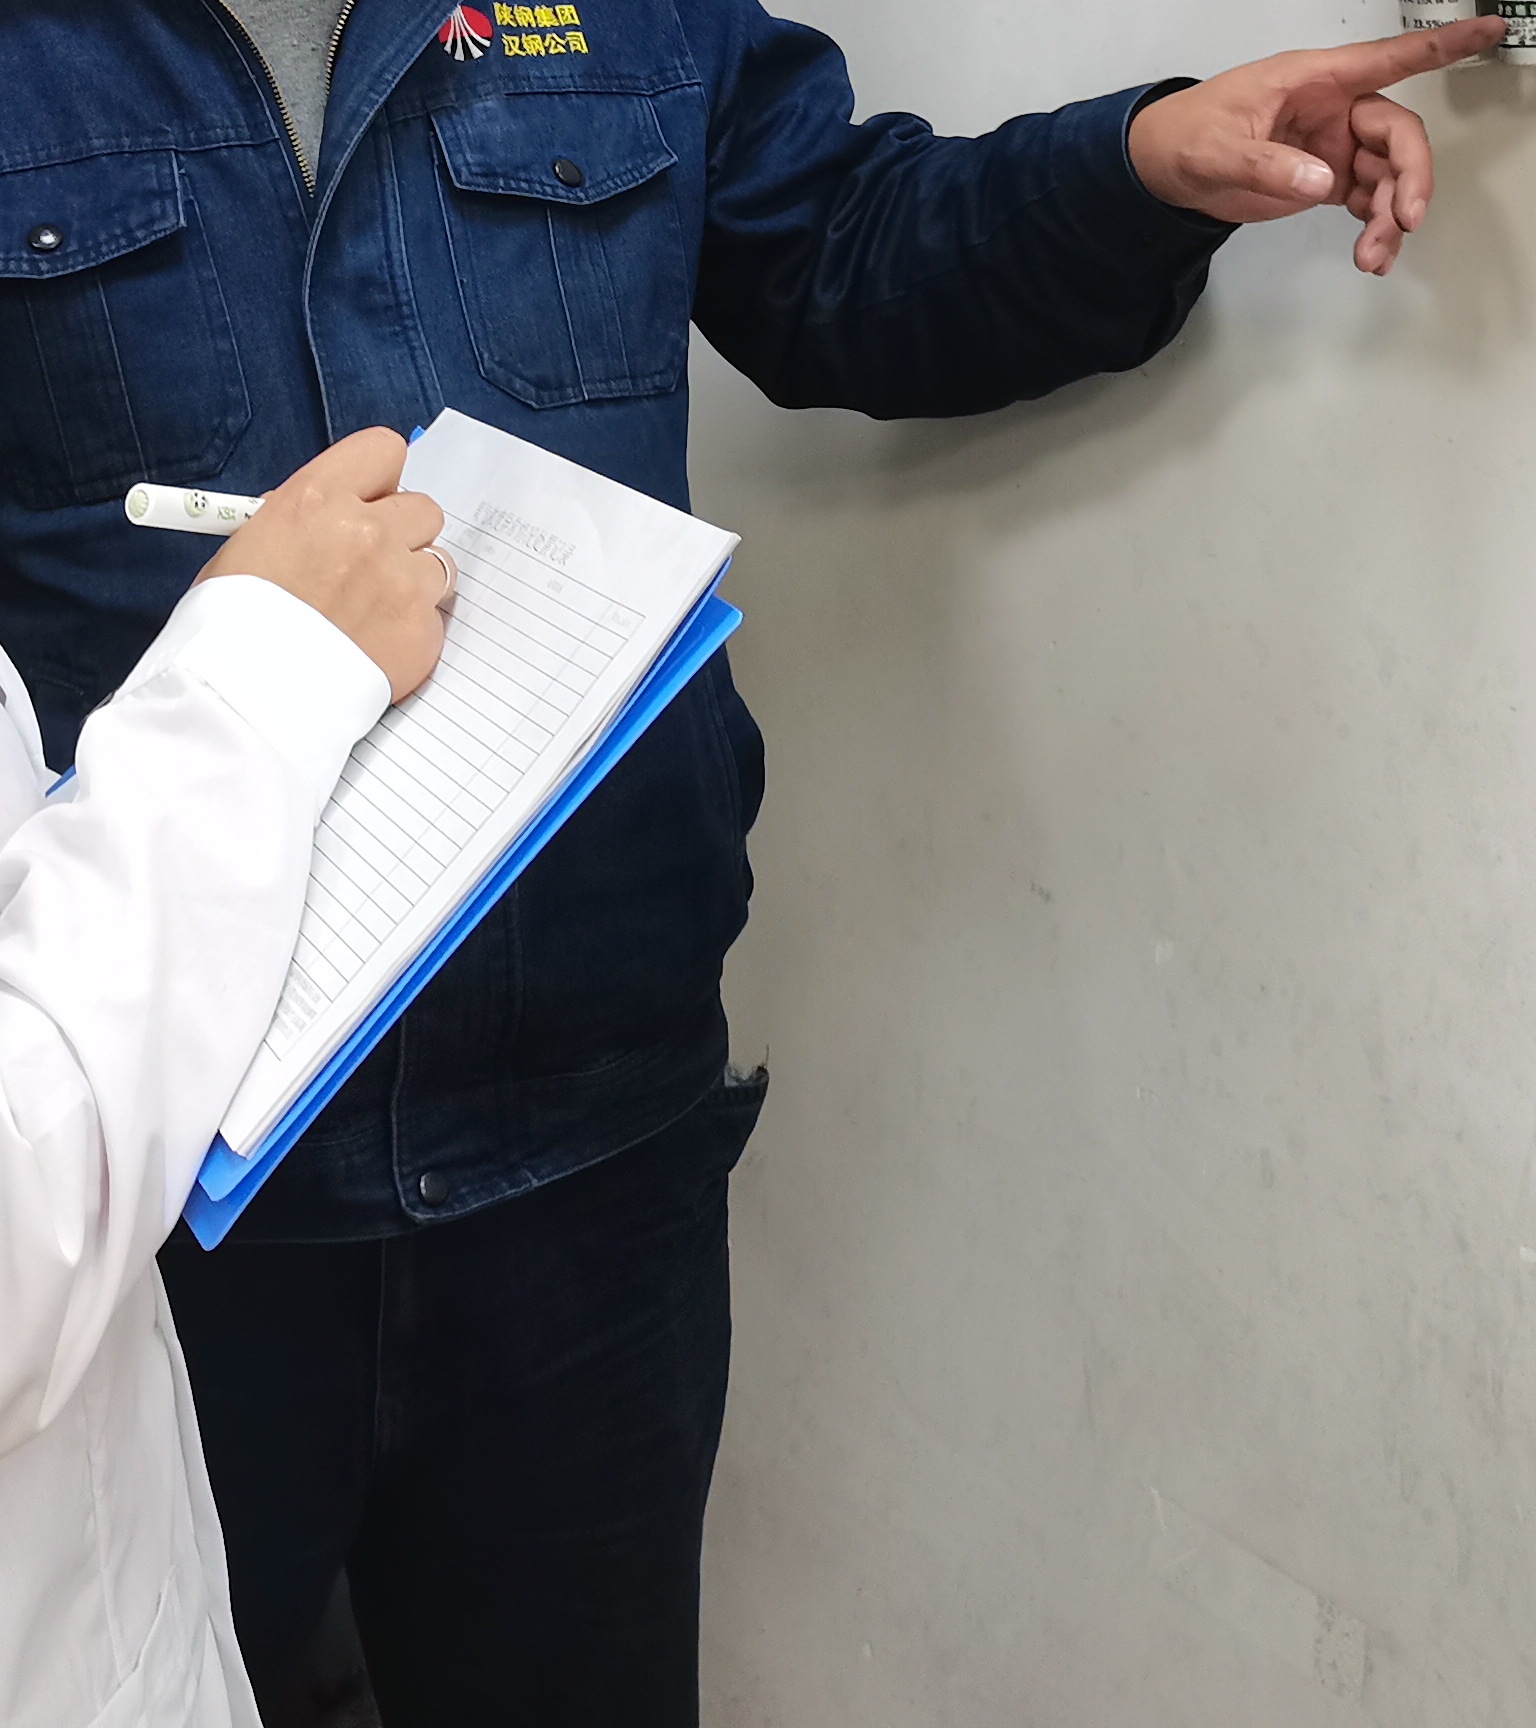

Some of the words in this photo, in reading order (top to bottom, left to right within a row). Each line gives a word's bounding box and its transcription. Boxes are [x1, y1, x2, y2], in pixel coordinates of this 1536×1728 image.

[493, 2, 581, 28] 陕钢集团
[502, 31, 589, 57] 汉钢公司
